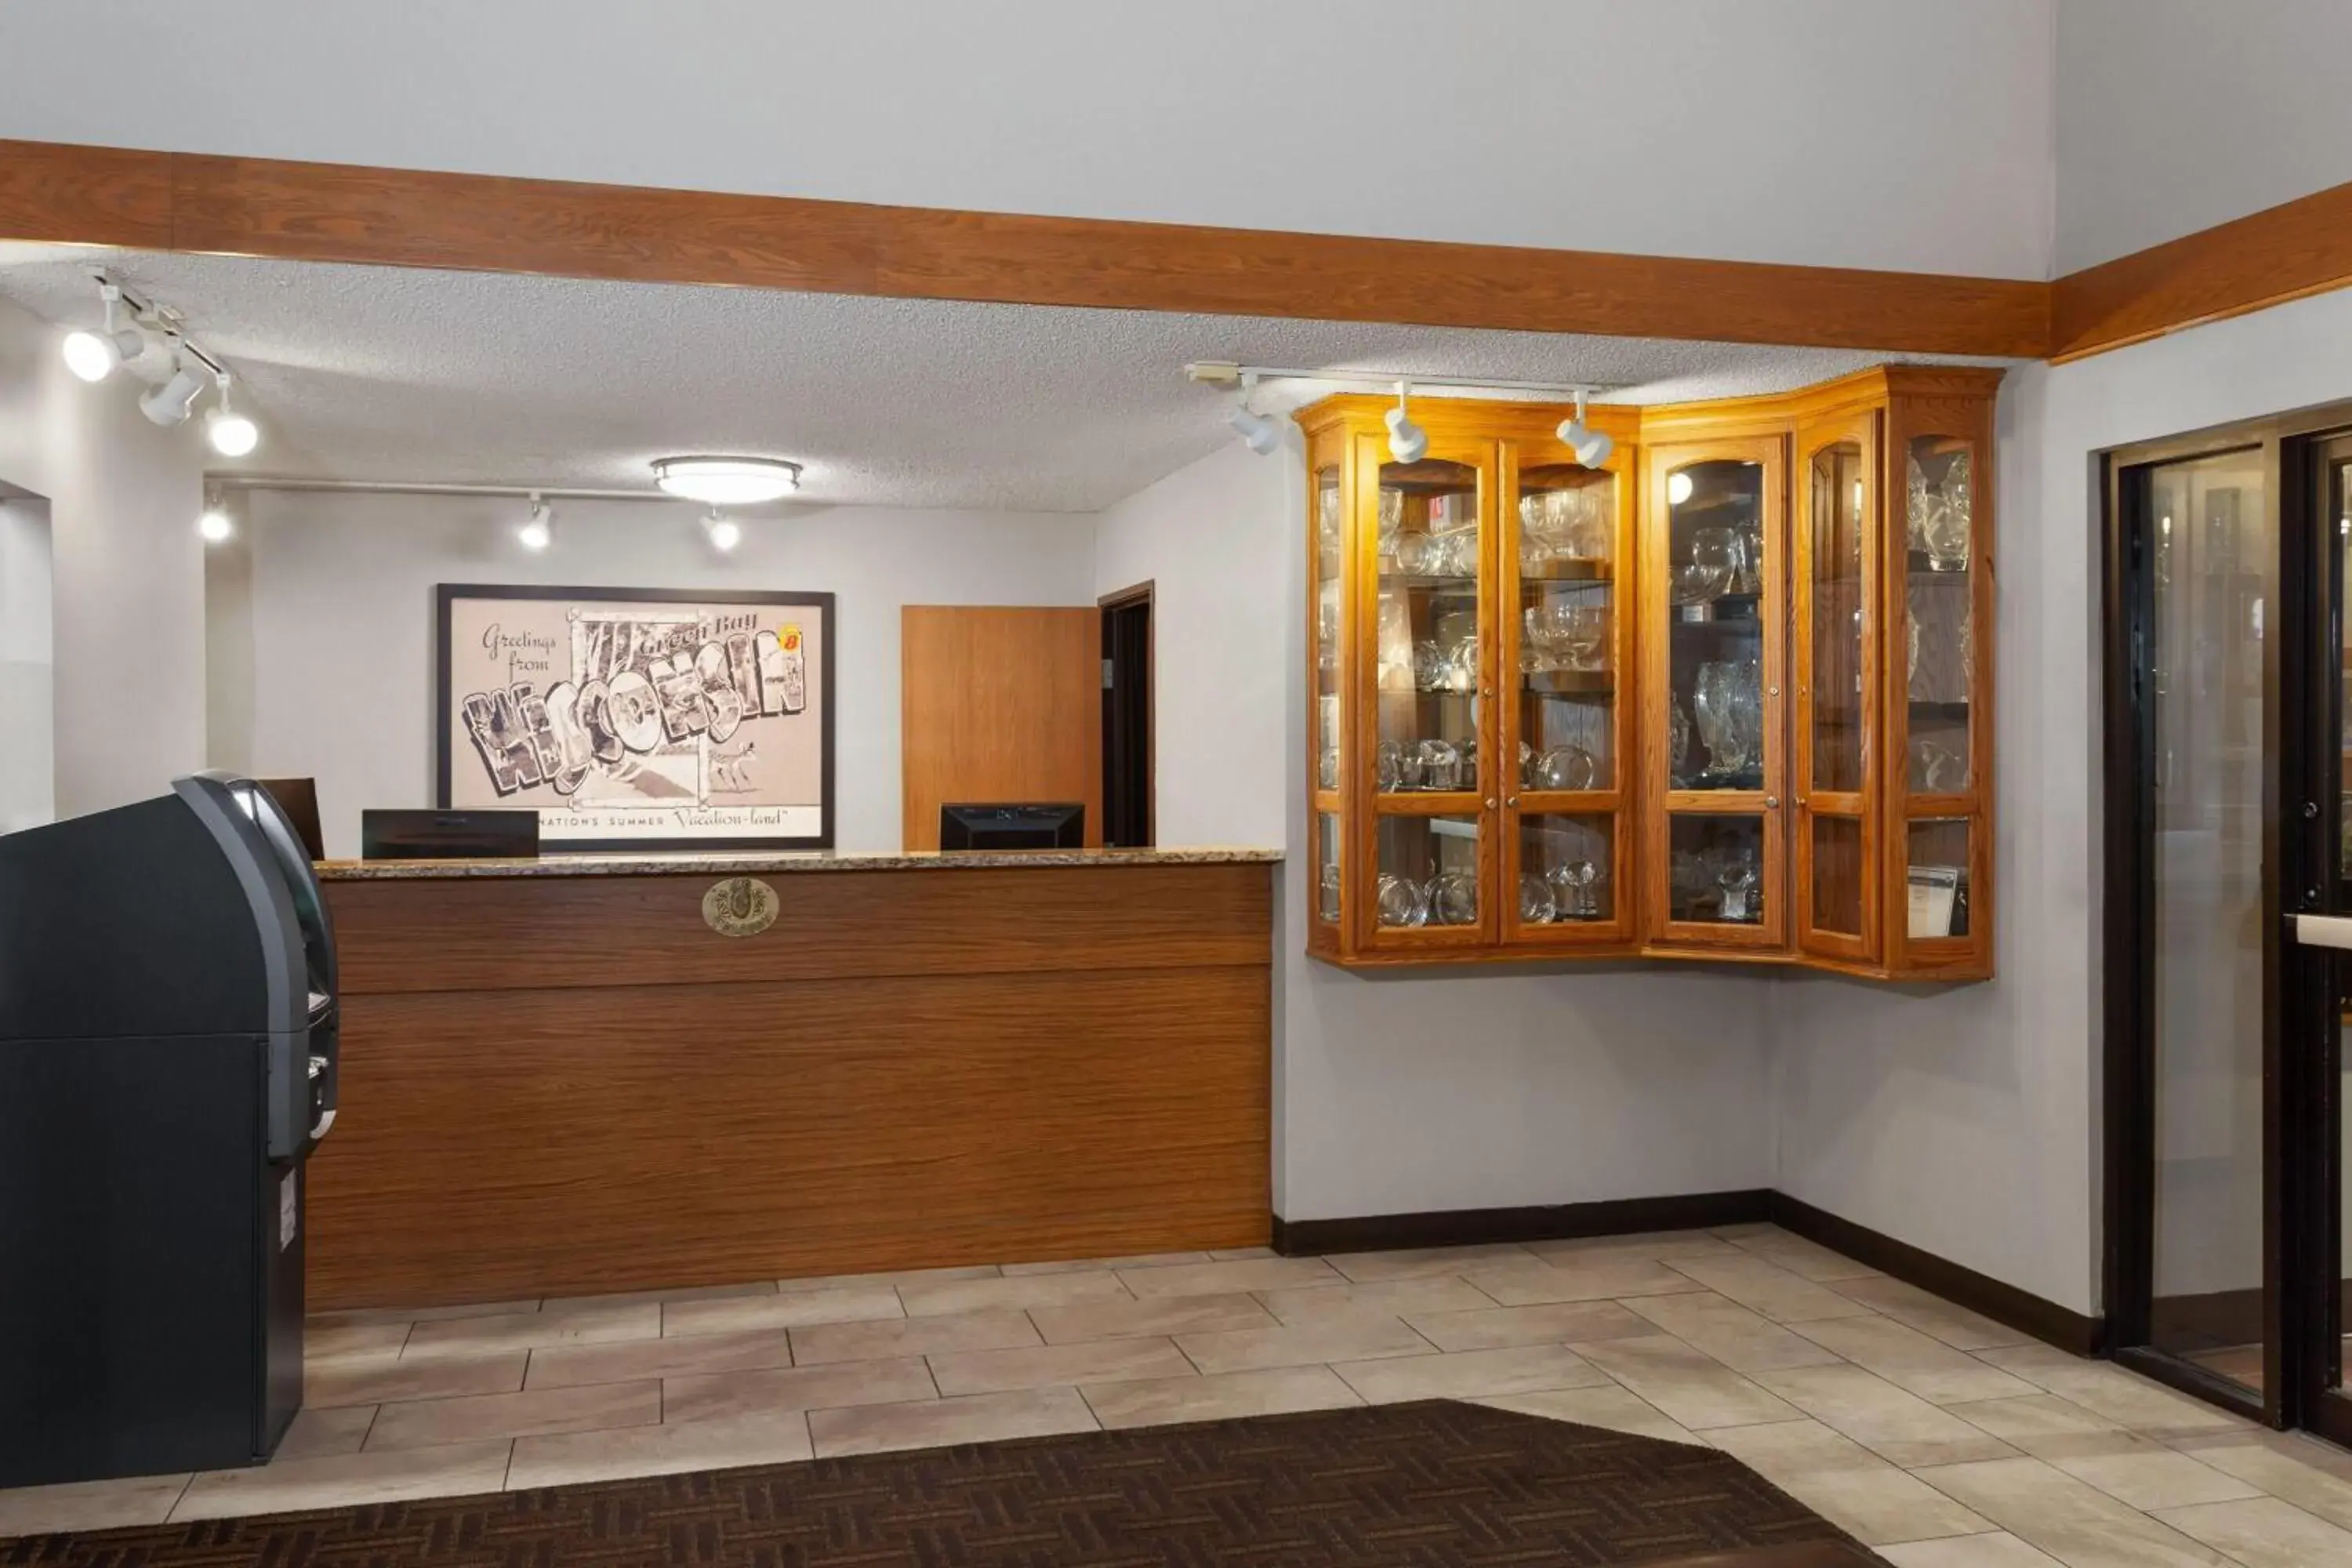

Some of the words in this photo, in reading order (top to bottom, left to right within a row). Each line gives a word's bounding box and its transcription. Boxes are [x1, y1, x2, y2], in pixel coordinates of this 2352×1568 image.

[482, 622, 557, 660] Greetings
[639, 626, 707, 654] Green
[715, 614, 757, 635] Bay
[508, 650, 549, 683] from
[462, 628, 805, 796] WISCONSIN
[609, 817, 665, 826] SUMMER
